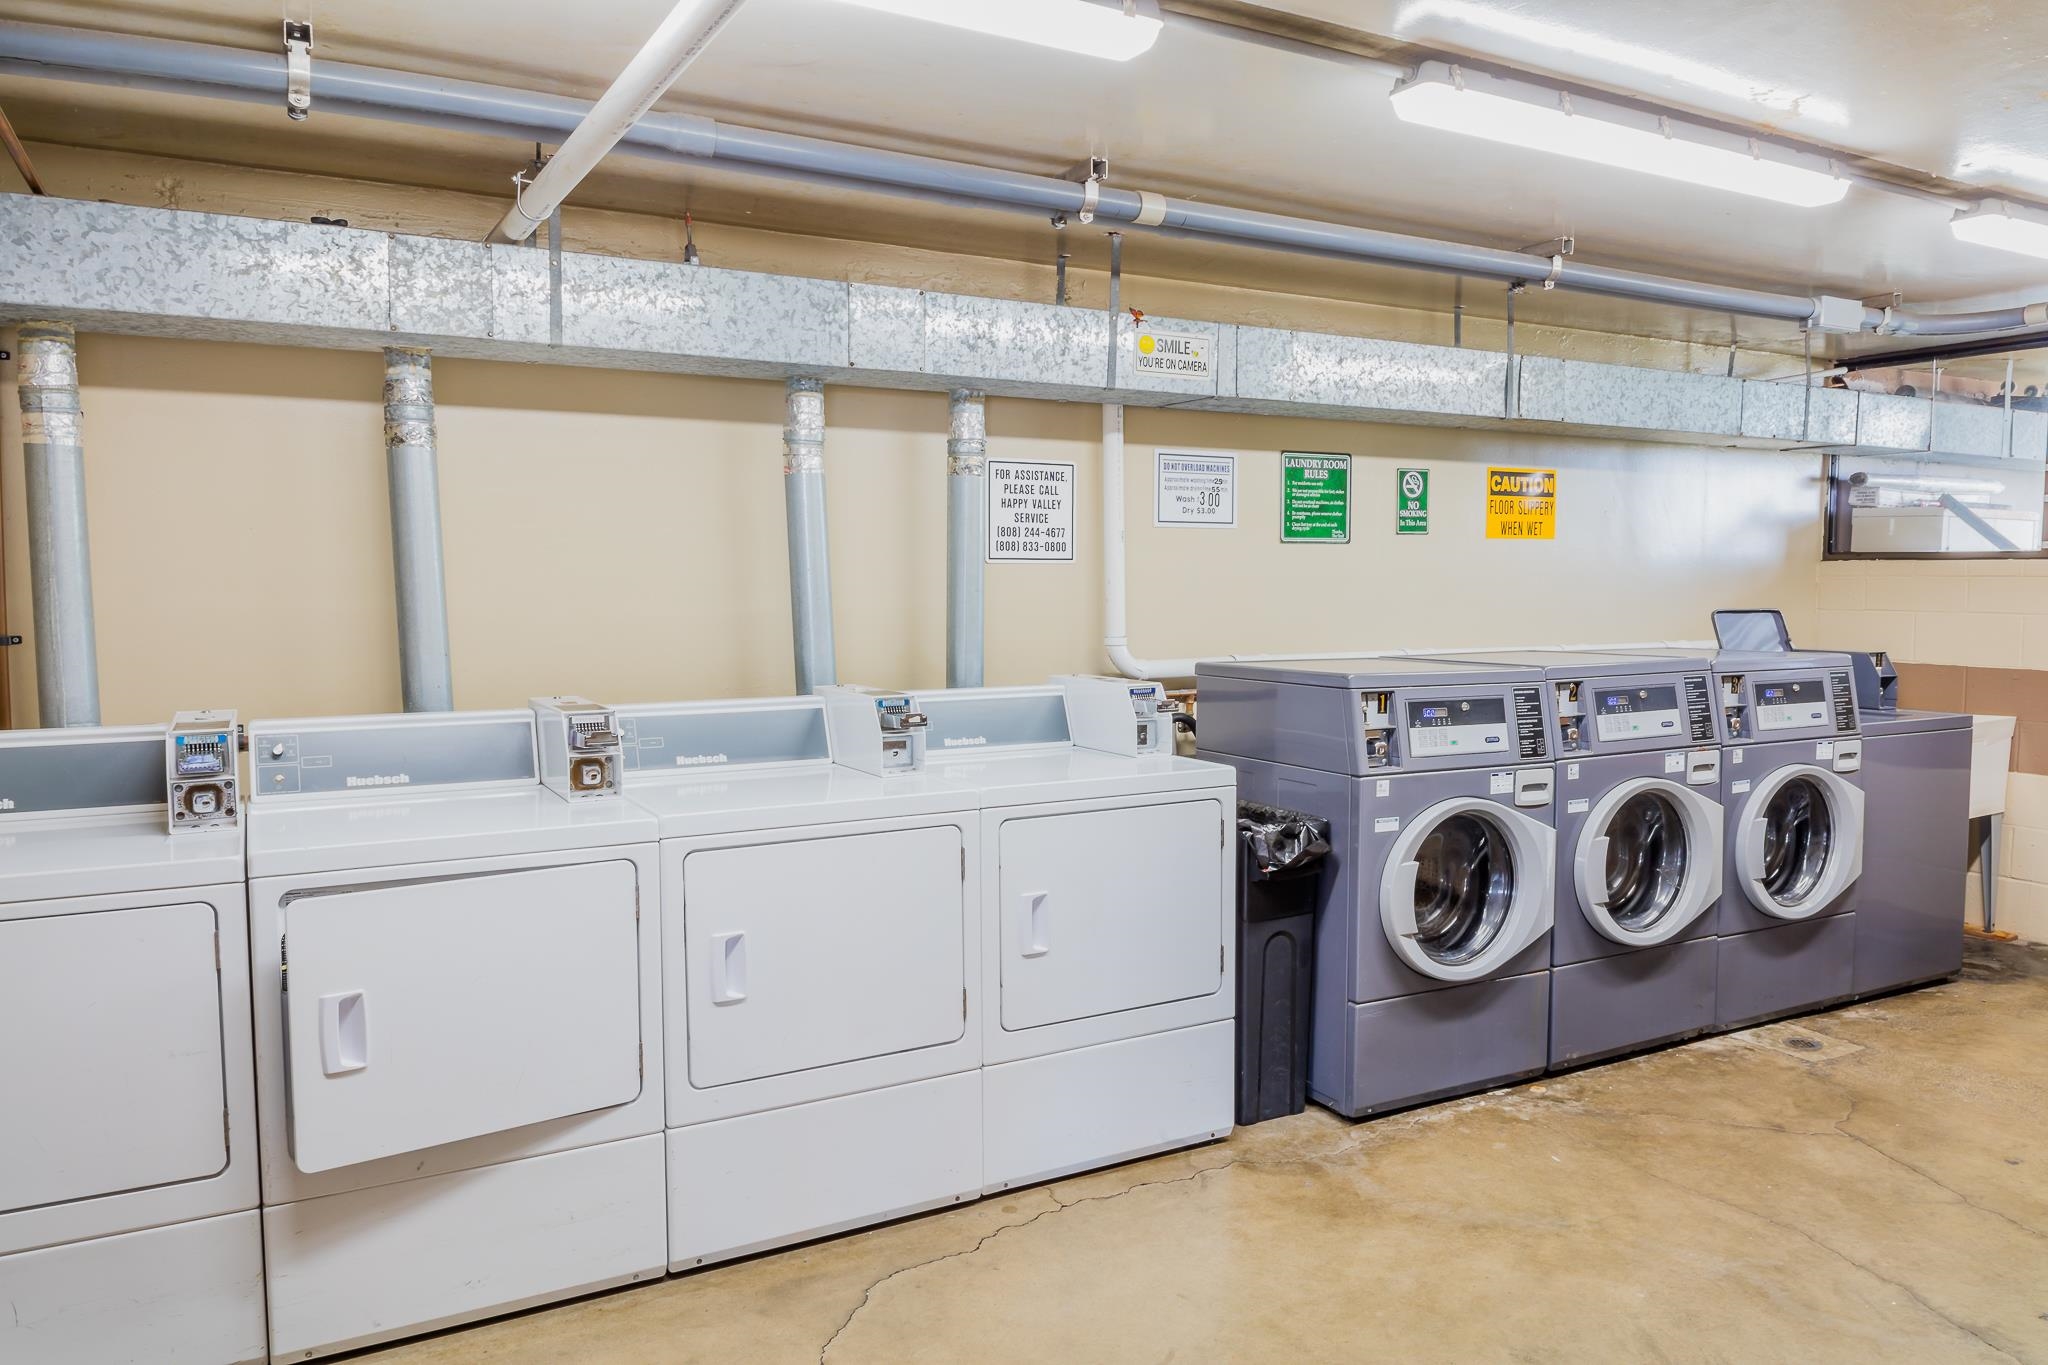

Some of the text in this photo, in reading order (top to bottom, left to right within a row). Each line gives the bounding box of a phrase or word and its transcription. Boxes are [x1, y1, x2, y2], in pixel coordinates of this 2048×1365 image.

[1138, 356, 1207, 372] YOU'RE ON CAMERA
[1164, 462, 1230, 472] DO NOT OVERLOAD MACHINES
[1286, 459, 1347, 469] LAUNDRY ROOM
[995, 469, 1068, 482] FOR ASSISTANCE,
[1304, 470, 1329, 479] RULES
[1004, 484, 1059, 495] PLEASE CALL
[1491, 475, 1554, 493] CAUTION
[1001, 498, 1061, 510] HAPPY VALLEY
[1408, 501, 1419, 510] NO
[1490, 500, 1554, 515] FLOOR SLIPPERY
[1182, 507, 1194, 515] Dry
[1014, 512, 1049, 524] SERVICE
[997, 526, 1066, 538] (808) 244-4677
[1501, 521, 1543, 536] WHEN WET
[996, 540, 1067, 552] (808) 833-0800
[1732, 677, 1738, 693] 3
[1570, 682, 1577, 701] 2
[1380, 694, 1385, 713] 1
[346, 773, 409, 787] Huebsch
